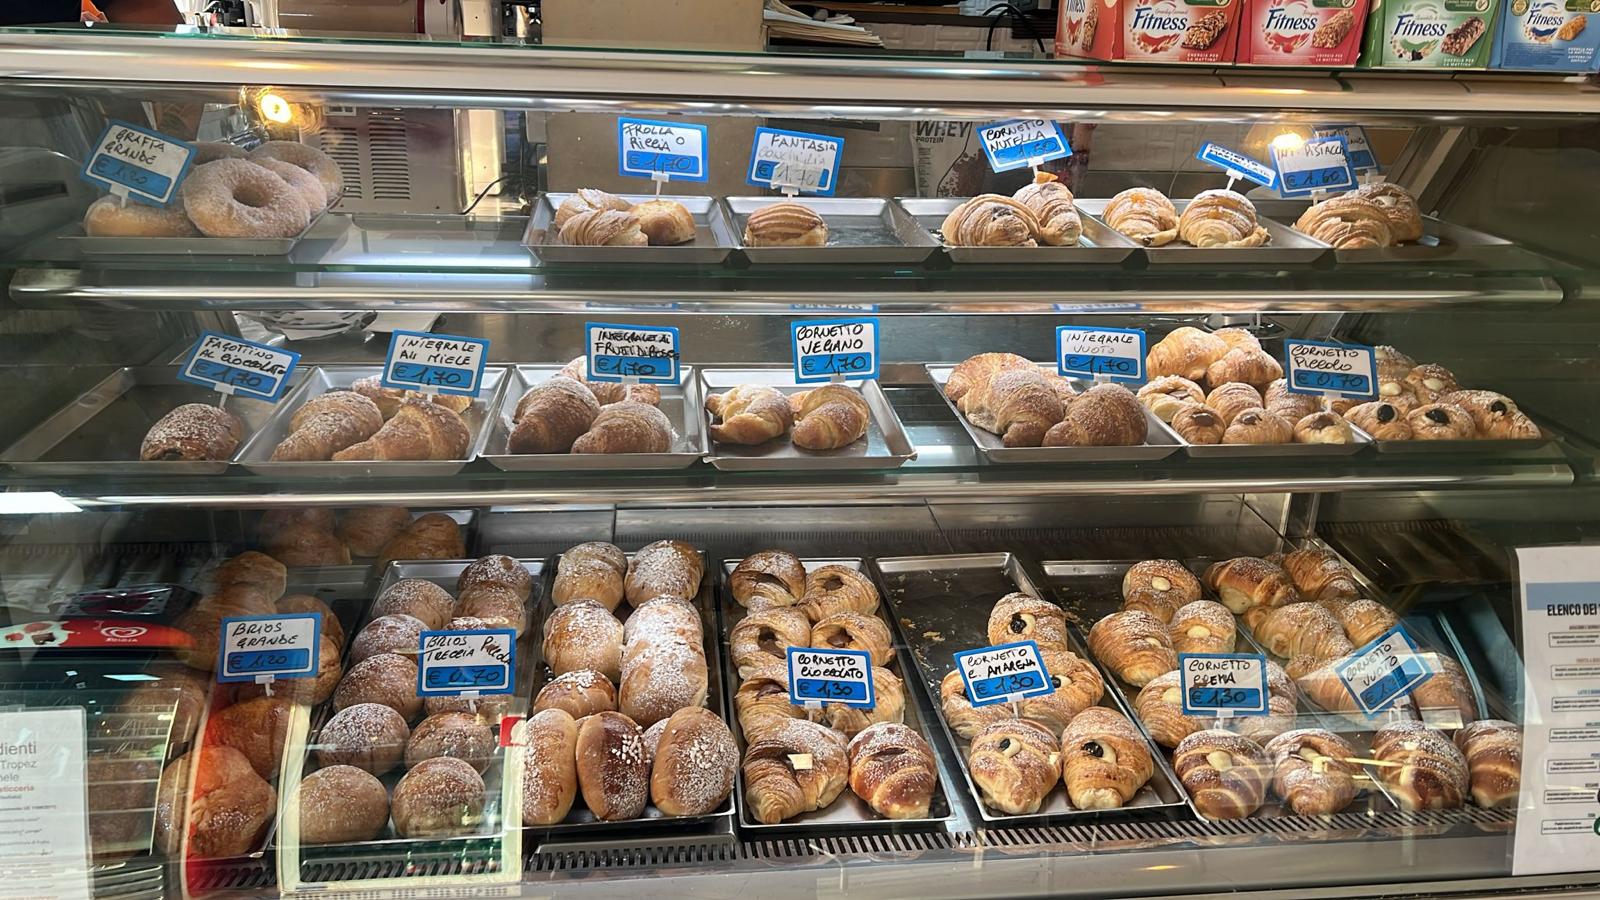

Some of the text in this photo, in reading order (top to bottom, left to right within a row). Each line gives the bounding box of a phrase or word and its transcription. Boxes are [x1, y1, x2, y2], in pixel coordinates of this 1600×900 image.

[1133, 7, 1188, 31] Fitness
[1266, 8, 1318, 30] Fitness
[1394, 13, 1448, 36] Fitness
[1527, 9, 1564, 25] Fitness
[916, 121, 970, 138] WHEY
[986, 119, 1045, 141] CORNETTO
[771, 133, 836, 152] FANTASIA
[989, 130, 1046, 152] NUTELLA
[797, 323, 864, 341] CORNETTO
[1066, 331, 1134, 345] INTEGRALE
[401, 336, 477, 353] INTEGRALE
[801, 338, 864, 355] VEGANO
[1073, 344, 1115, 354] VUOTO
[1290, 345, 1360, 358] CORNETTO
[427, 353, 472, 366] MIELE
[1547, 603, 1598, 616] ELENCO DEI
[232, 622, 282, 637] BRIOS
[236, 633, 299, 649] GRANDE
[426, 636, 468, 648] BRIOS
[423, 646, 475, 661] TRECCIA
[798, 653, 856, 667] CORNETTO
[967, 648, 1027, 667] CORNETTO
[987, 658, 1036, 678] AMARENA
[1189, 659, 1251, 672] CORNETTO
[1346, 643, 1392, 682] CORNETTO
[1362, 655, 1398, 687] VUOTO
[1193, 672, 1237, 687] CREMA
